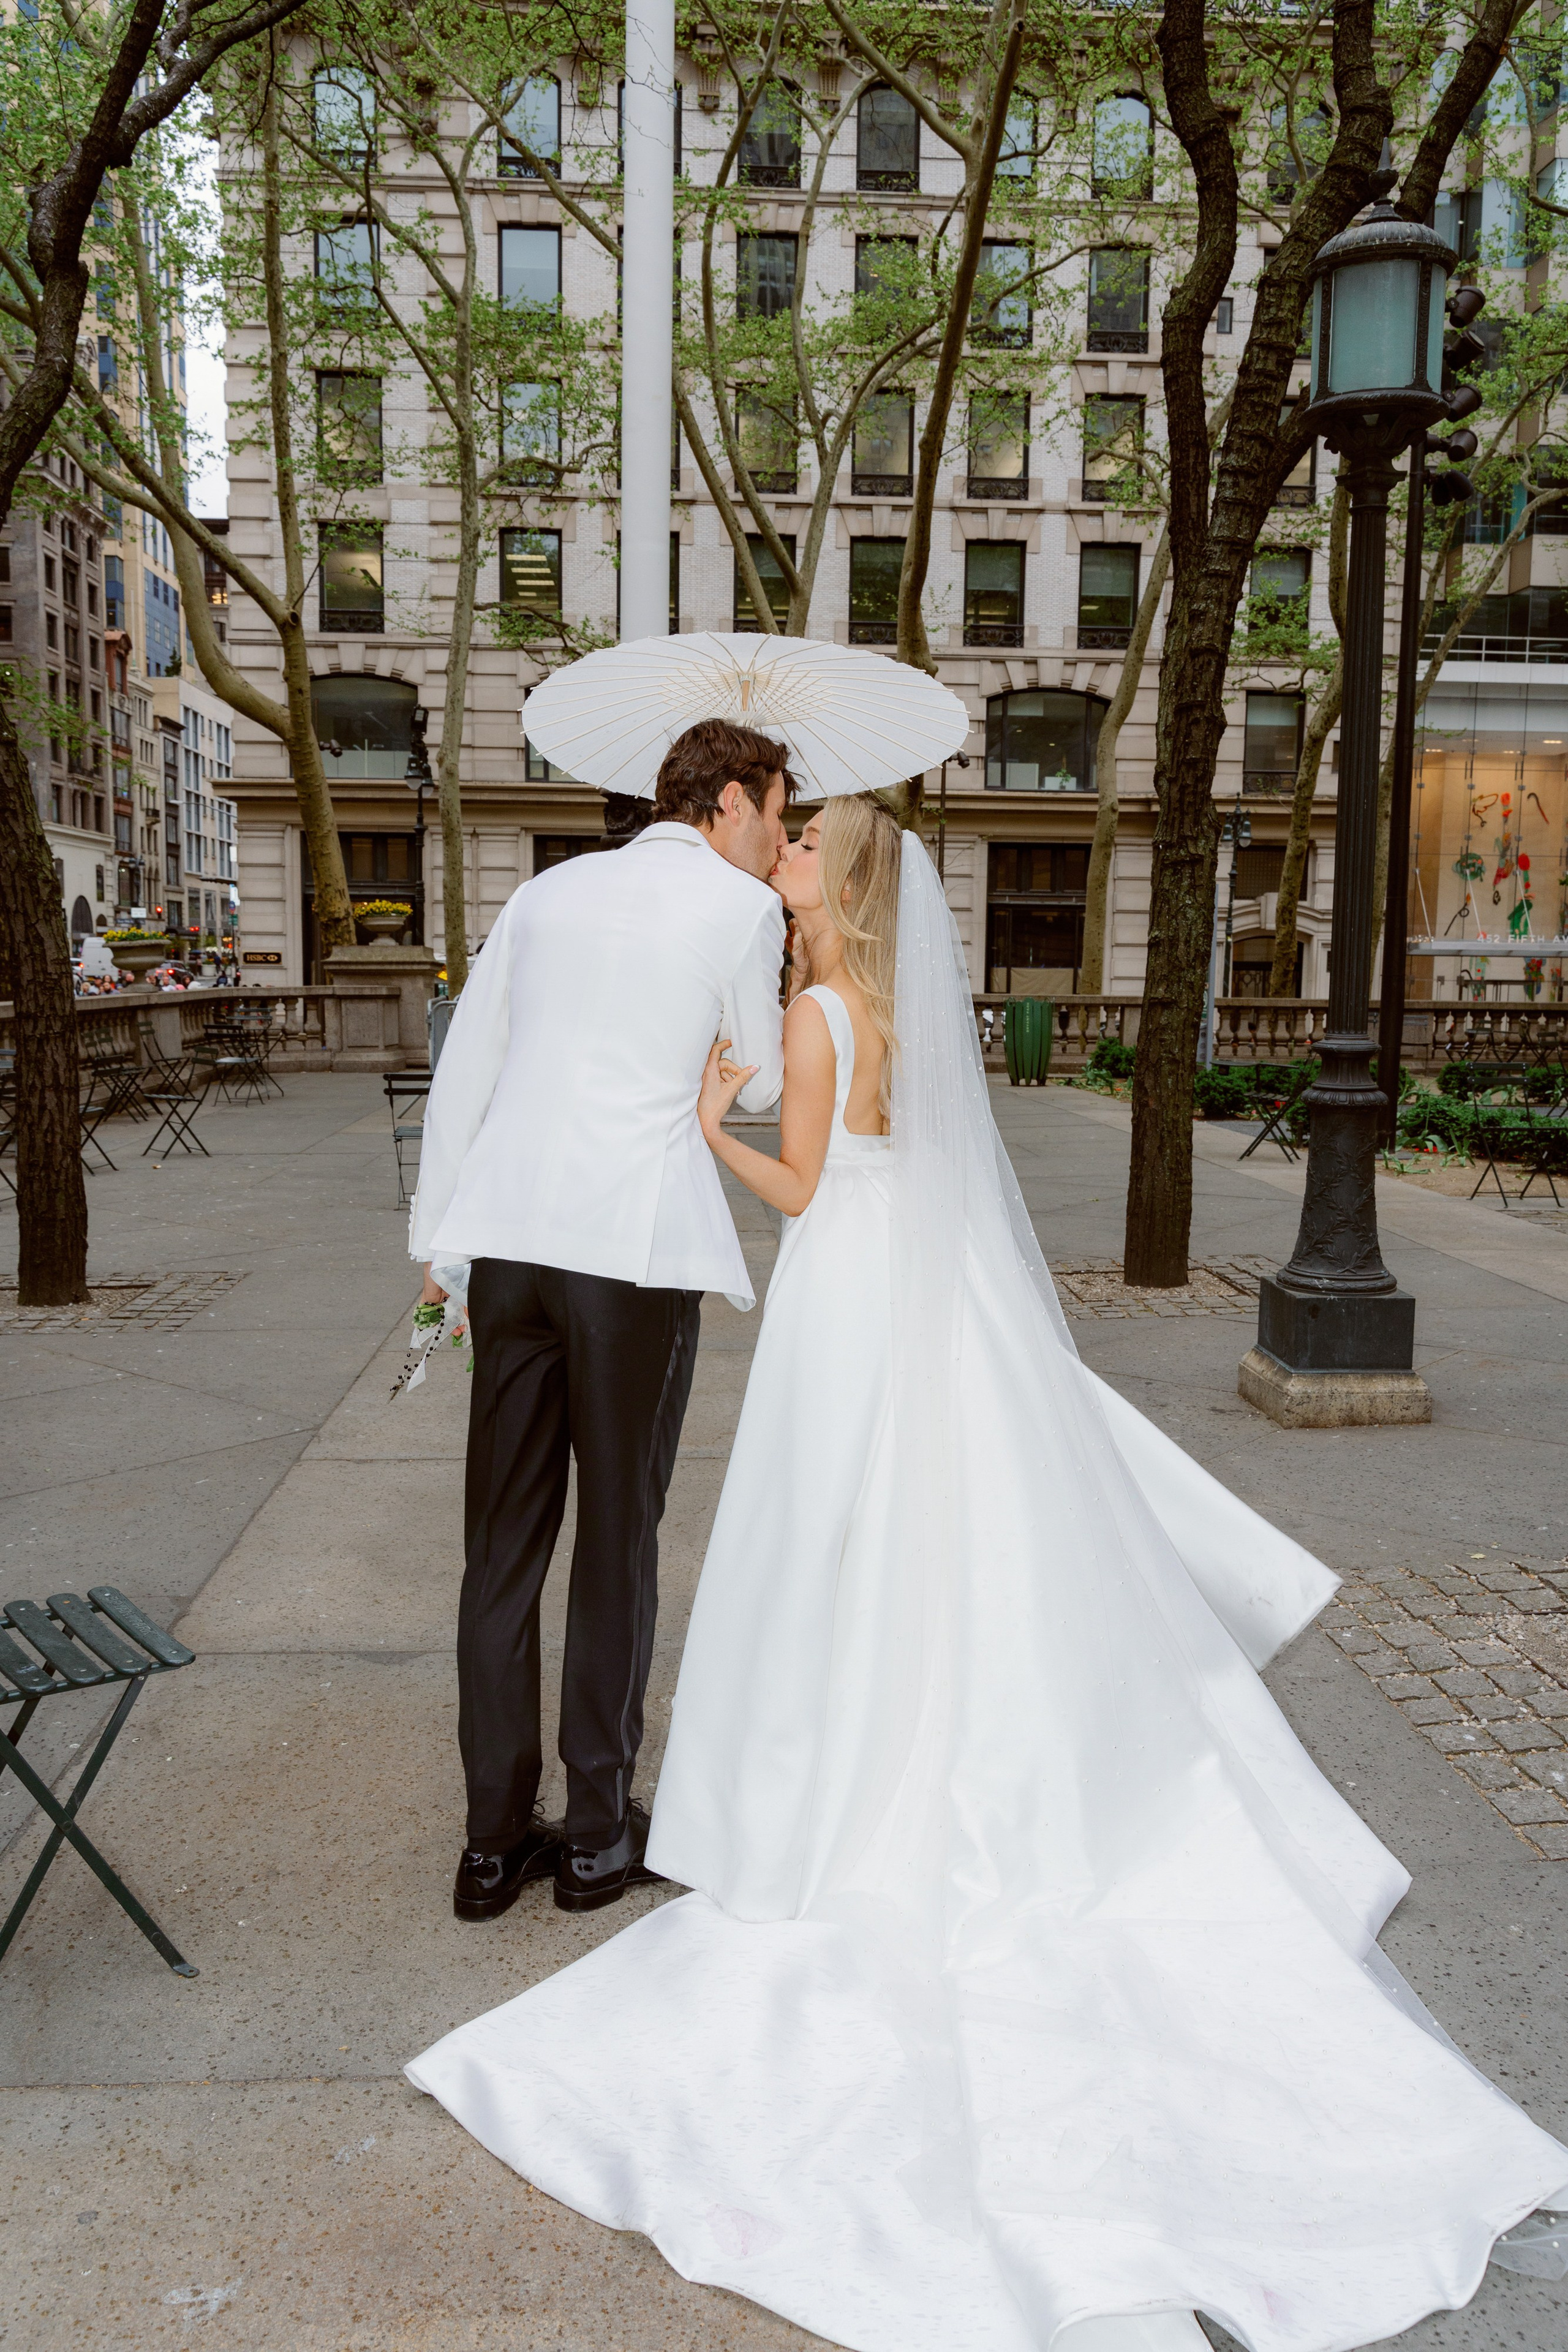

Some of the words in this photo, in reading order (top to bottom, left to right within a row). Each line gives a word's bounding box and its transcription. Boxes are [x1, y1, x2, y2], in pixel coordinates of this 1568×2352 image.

[1477, 934, 1500, 943] 452
[1508, 934, 1545, 943] FIFTH
[130, 1619, 157, 1635] PARK
